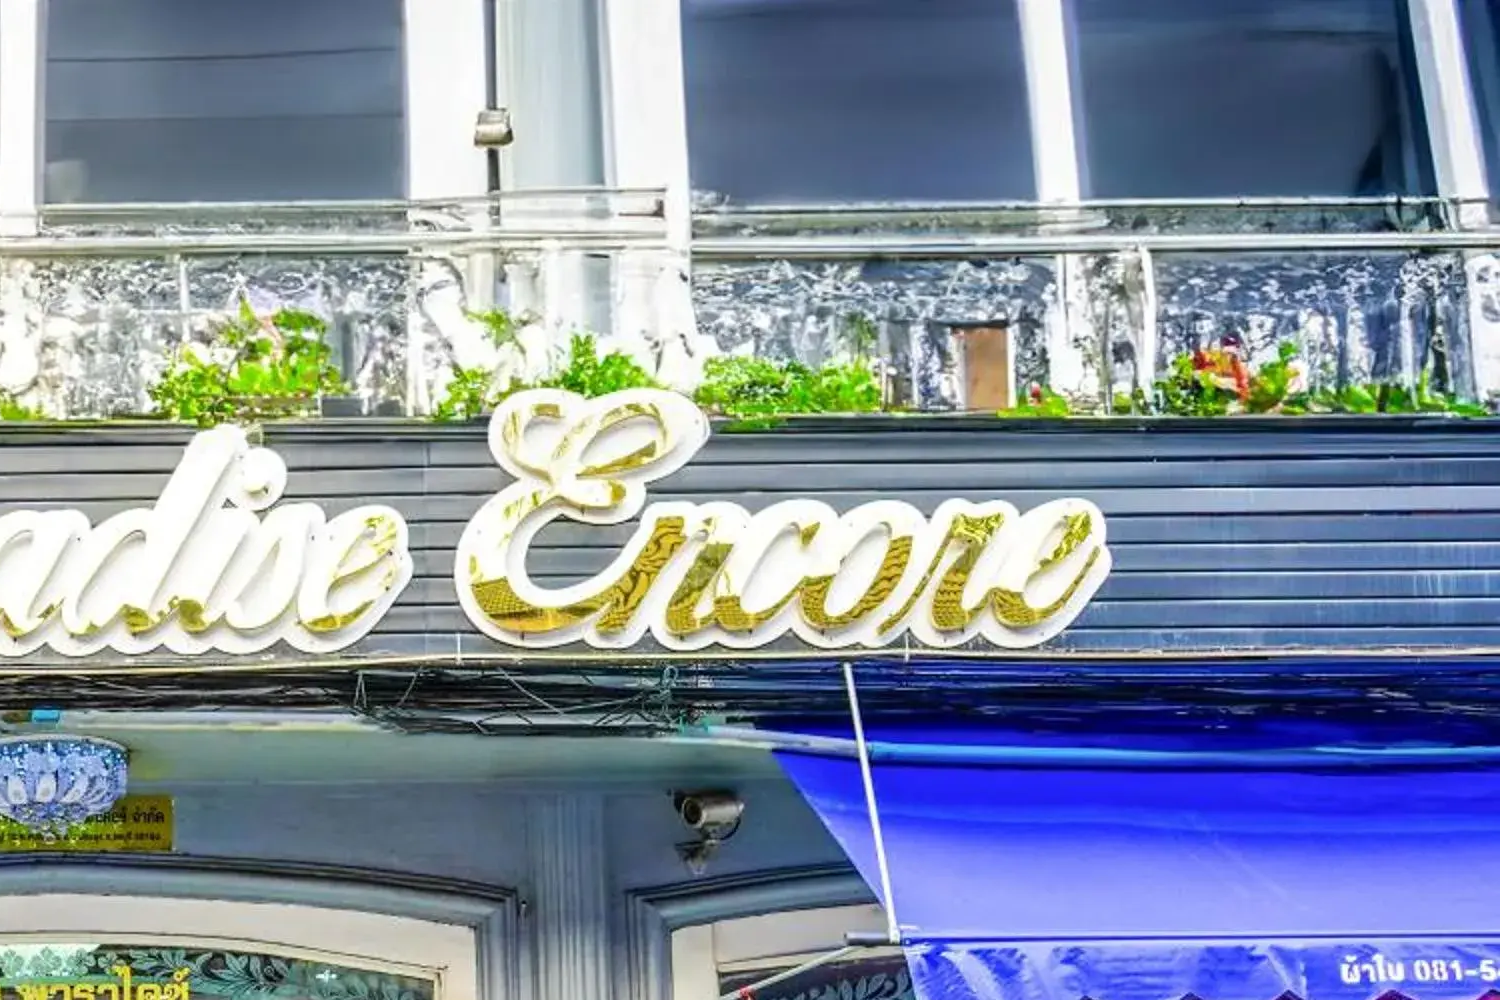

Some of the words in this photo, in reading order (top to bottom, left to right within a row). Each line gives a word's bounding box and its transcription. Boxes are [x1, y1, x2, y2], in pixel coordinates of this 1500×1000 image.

[454, 388, 1112, 650] Encore
[1340, 953, 1406, 985] ผ้าใบ
[1414, 959, 1500, 982] 081-5
